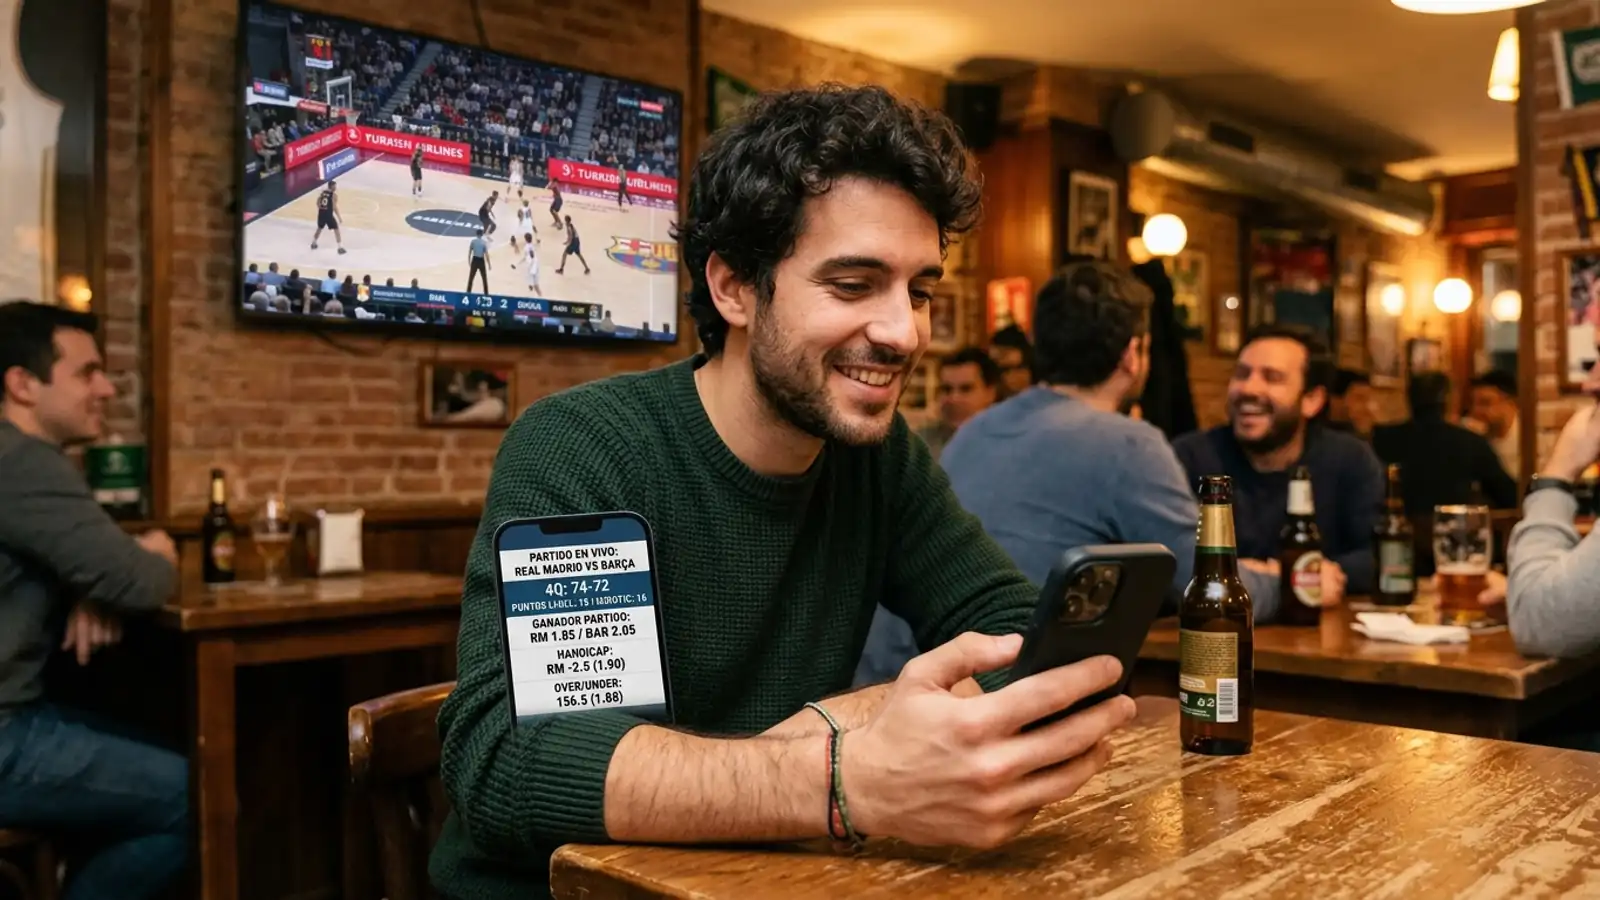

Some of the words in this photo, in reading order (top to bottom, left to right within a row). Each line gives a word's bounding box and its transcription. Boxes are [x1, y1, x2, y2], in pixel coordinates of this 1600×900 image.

[529, 550, 573, 562] PARTIDO
[575, 549, 589, 559] EN
[591, 546, 618, 558] VIVO:
[515, 565, 540, 577] REAL
[585, 561, 599, 571] VS
[601, 559, 636, 571] BARÇA
[545, 582, 568, 597] 4Q:
[571, 579, 610, 594] 74-72
[637, 593, 648, 602] 16
[532, 615, 582, 629] GANADOR
[530, 632, 548, 643] RM
[552, 629, 575, 642] 1.85
[578, 628, 583, 640] /
[585, 626, 609, 639] BAR
[611, 624, 636, 637] 2.05
[546, 663, 565, 675] RM
[568, 660, 590, 673] -2.5
[593, 656, 626, 674] (1.90)
[554, 678, 622, 693] OVER/UNDER:
[556, 693, 588, 707] 156.5
[590, 690, 623, 707] (1.88)
